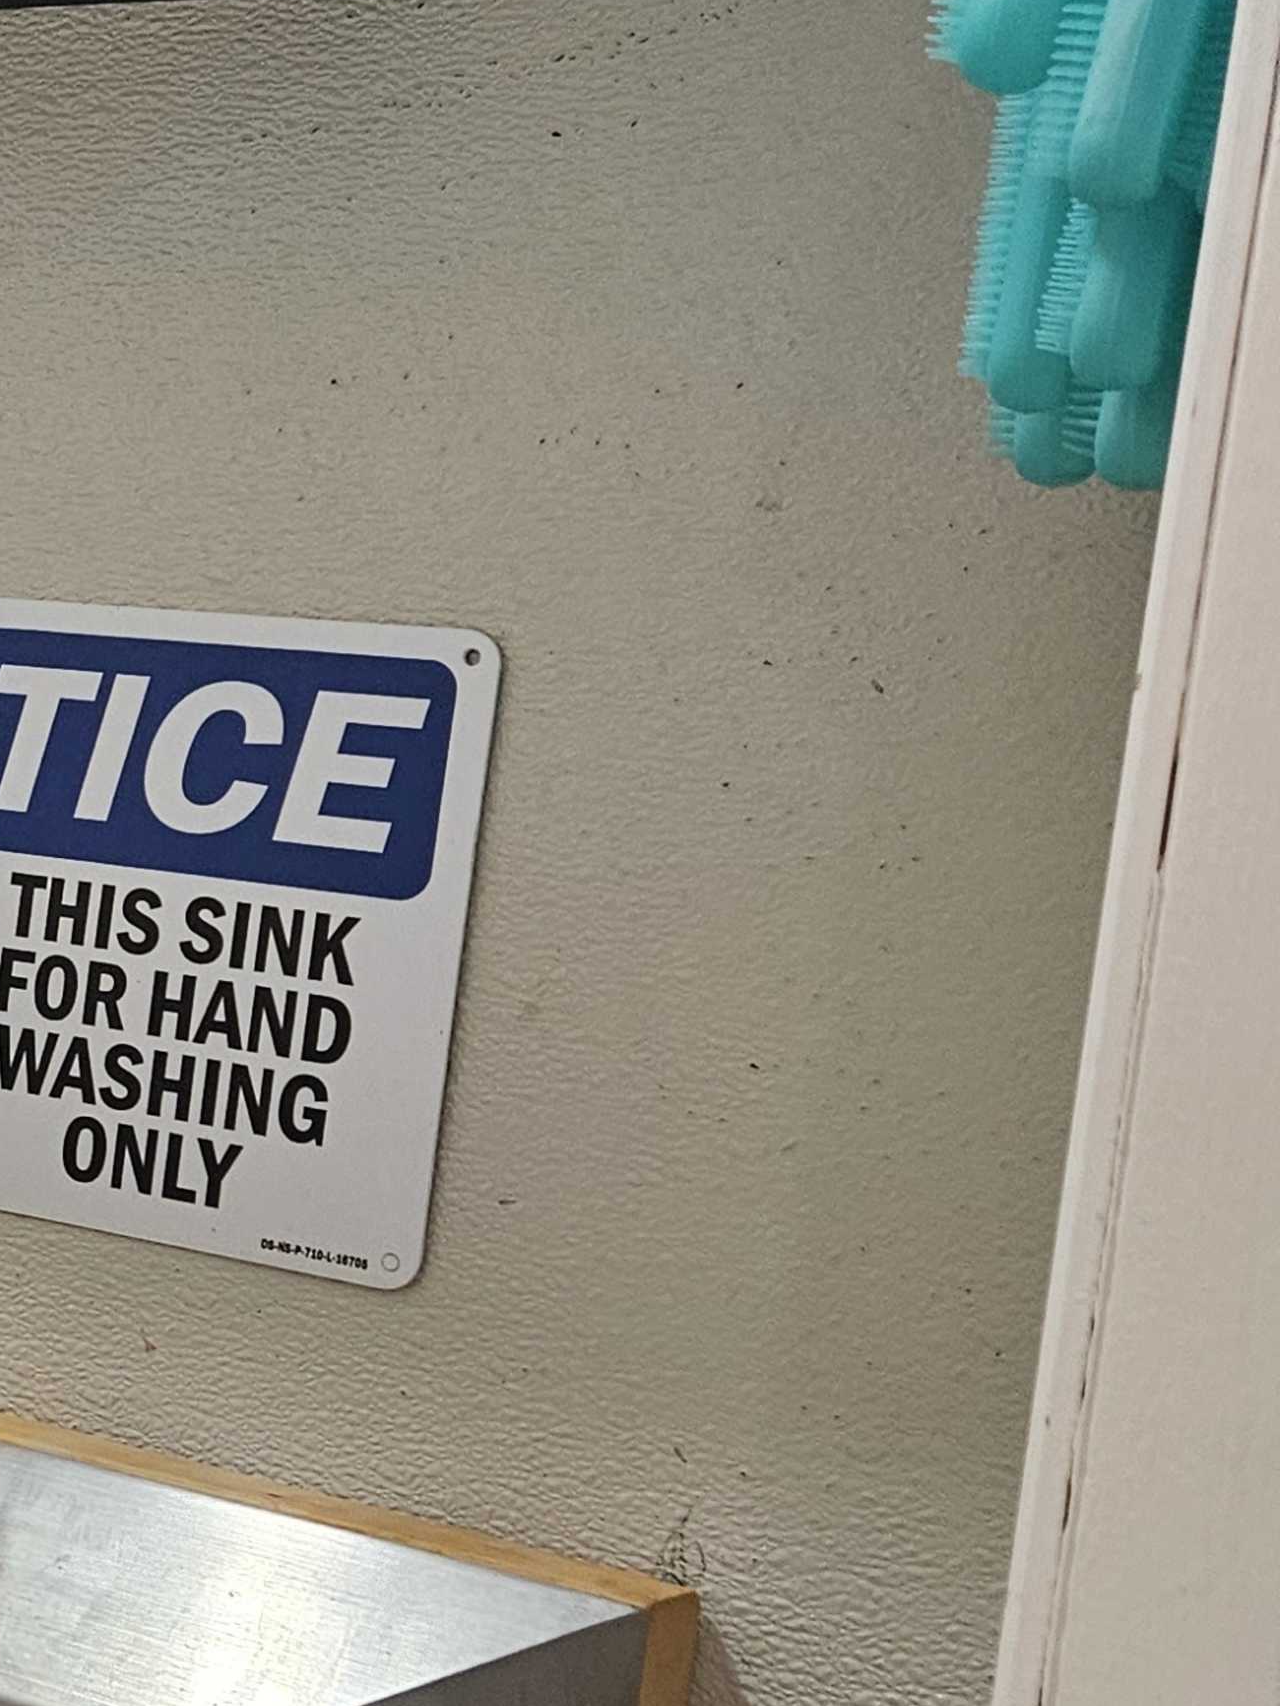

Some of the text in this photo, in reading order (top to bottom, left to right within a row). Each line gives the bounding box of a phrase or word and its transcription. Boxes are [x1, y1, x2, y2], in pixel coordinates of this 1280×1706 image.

[10, 871, 361, 987] THIS SINK
[146, 970, 352, 1065] HAND
[62, 1115, 244, 1209] ONLY
